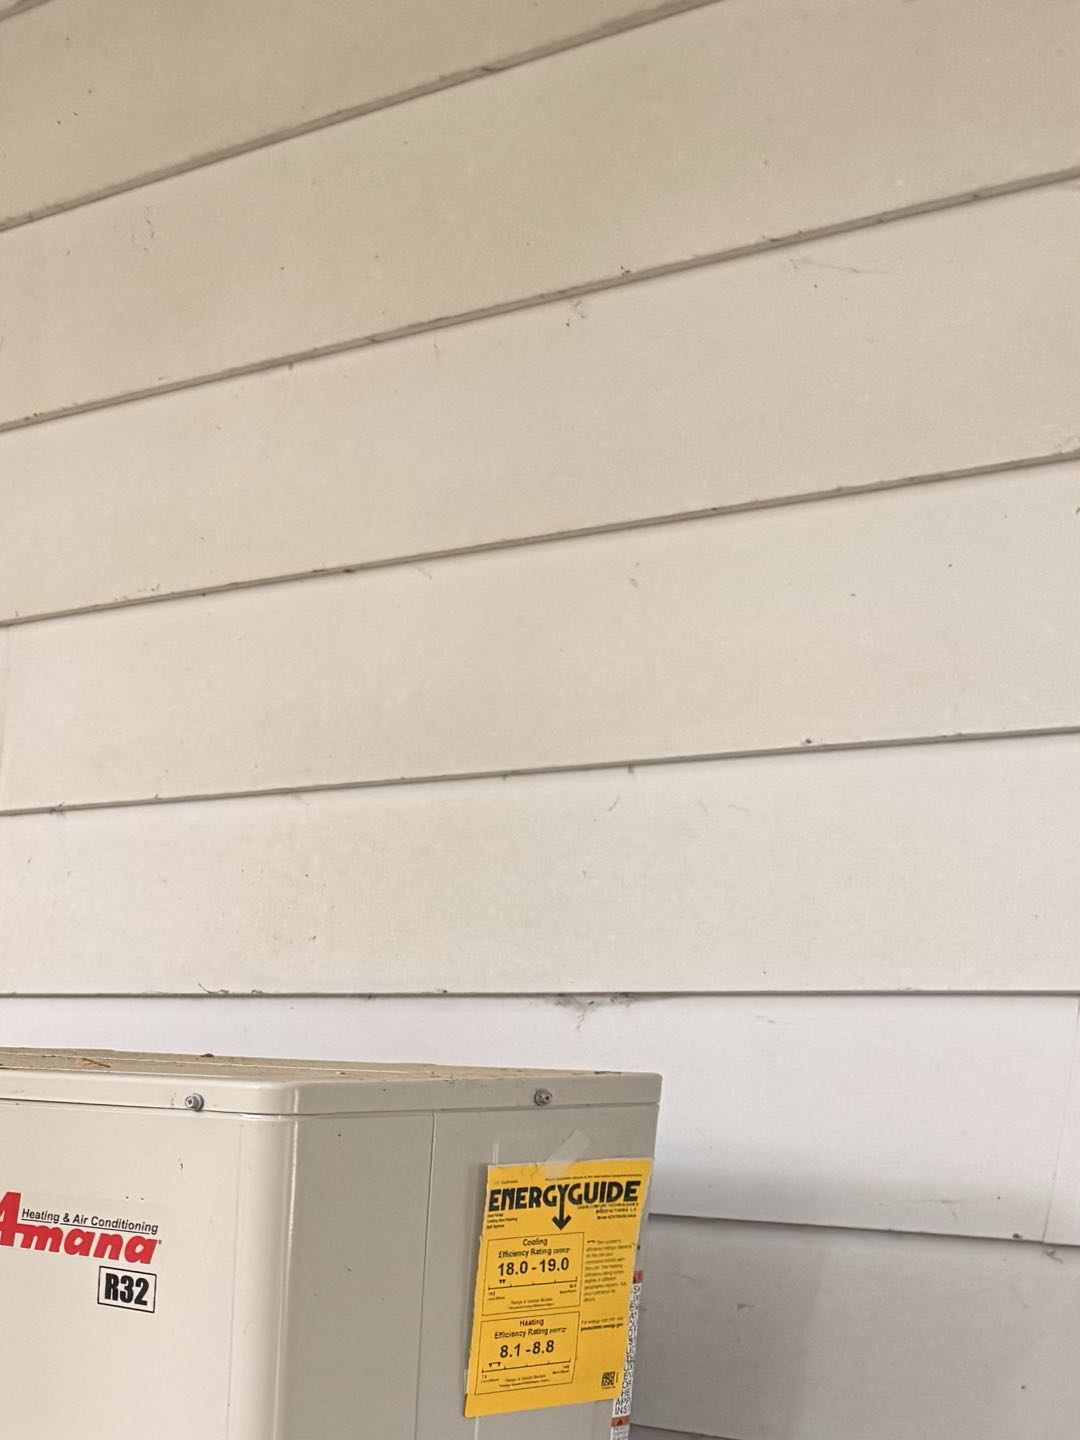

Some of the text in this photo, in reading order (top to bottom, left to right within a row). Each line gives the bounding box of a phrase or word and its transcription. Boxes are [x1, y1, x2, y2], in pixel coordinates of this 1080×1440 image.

[488, 1180, 641, 1212] ENERGYGUIDE
[21, 1208, 159, 1235] Heating & Air Conditioning
[522, 1238, 548, 1246] Cooling
[498, 1249, 529, 1258] Efficiency
[530, 1247, 552, 1256] Rating
[498, 1260, 528, 1276] 18.0
[539, 1257, 569, 1273] 19.0
[104, 1272, 149, 1306] R32
[520, 1318, 544, 1327] Heating
[494, 1330, 526, 1339] Efficiency
[527, 1327, 549, 1336] Rating
[500, 1343, 521, 1358] 8.1
[532, 1339, 555, 1355] 8.8
